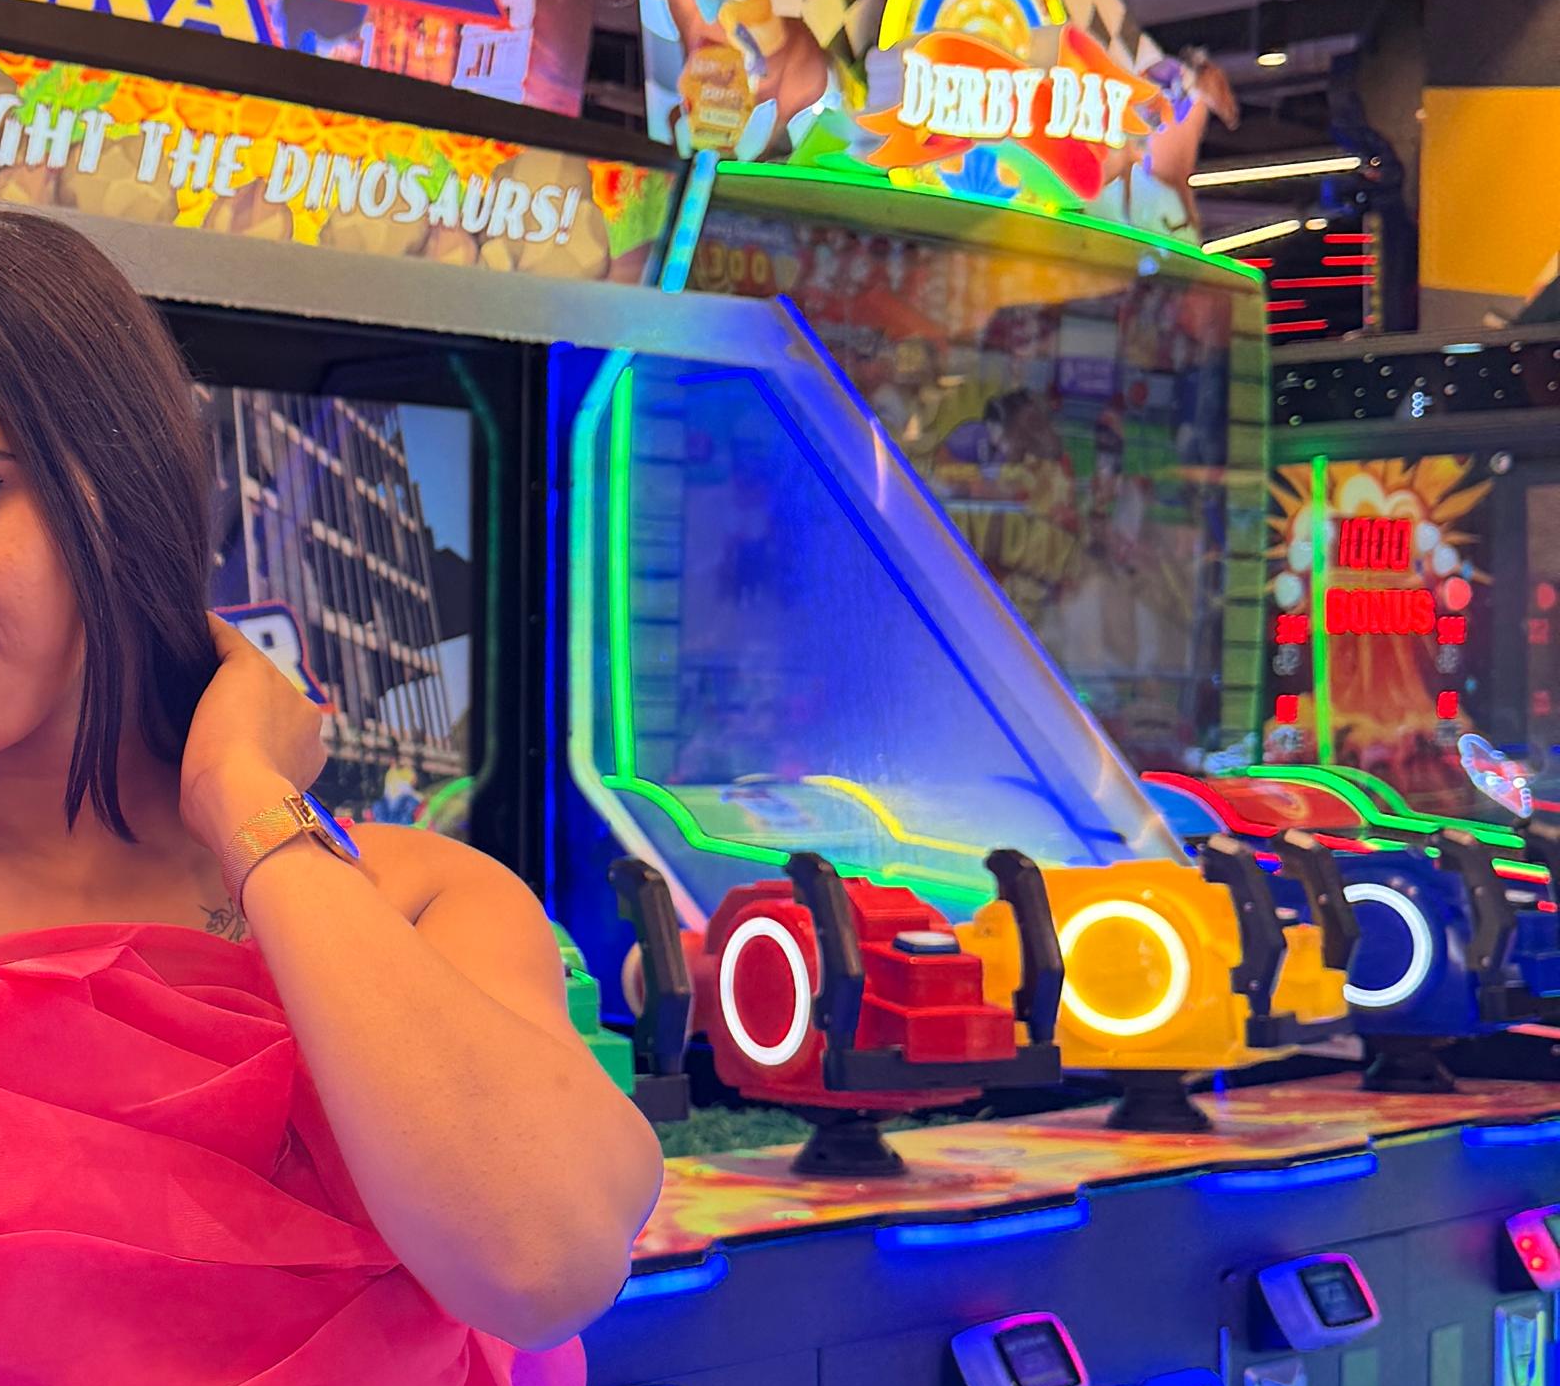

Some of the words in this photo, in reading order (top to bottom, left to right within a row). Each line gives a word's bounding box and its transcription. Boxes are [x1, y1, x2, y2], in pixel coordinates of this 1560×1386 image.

[897, 49, 1044, 139] DERBY
[1044, 67, 1134, 150] DAY
[136, 120, 251, 197] THE
[264, 141, 581, 245] DINOSAURS!
[1339, 517, 1412, 573] 1000
[1326, 587, 1436, 635] BONUS
